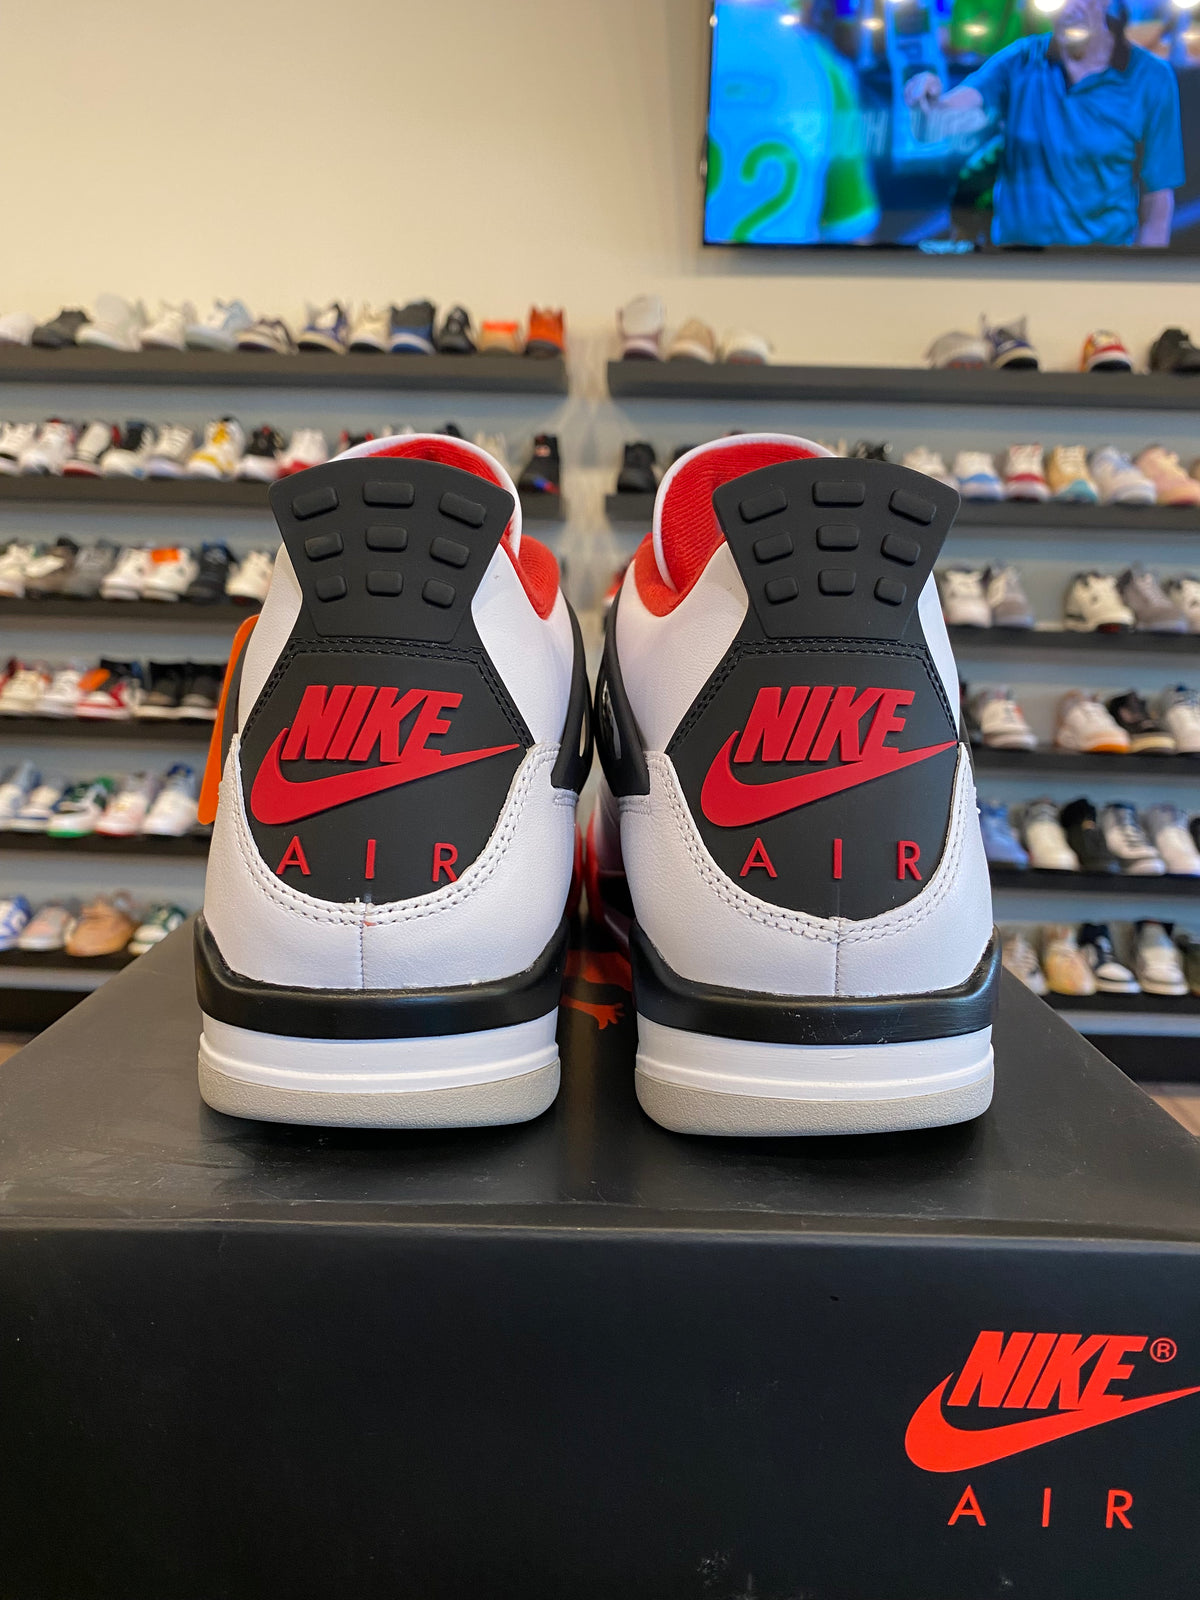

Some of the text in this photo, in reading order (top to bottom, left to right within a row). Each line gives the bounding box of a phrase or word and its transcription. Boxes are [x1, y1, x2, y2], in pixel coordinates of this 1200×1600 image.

[708, 141, 799, 242] 2
[280, 684, 464, 764] NIKE
[733, 685, 916, 764] NIKE
[275, 836, 459, 883] AIR
[739, 837, 923, 881] AIR
[946, 1484, 1134, 1530] AIR
